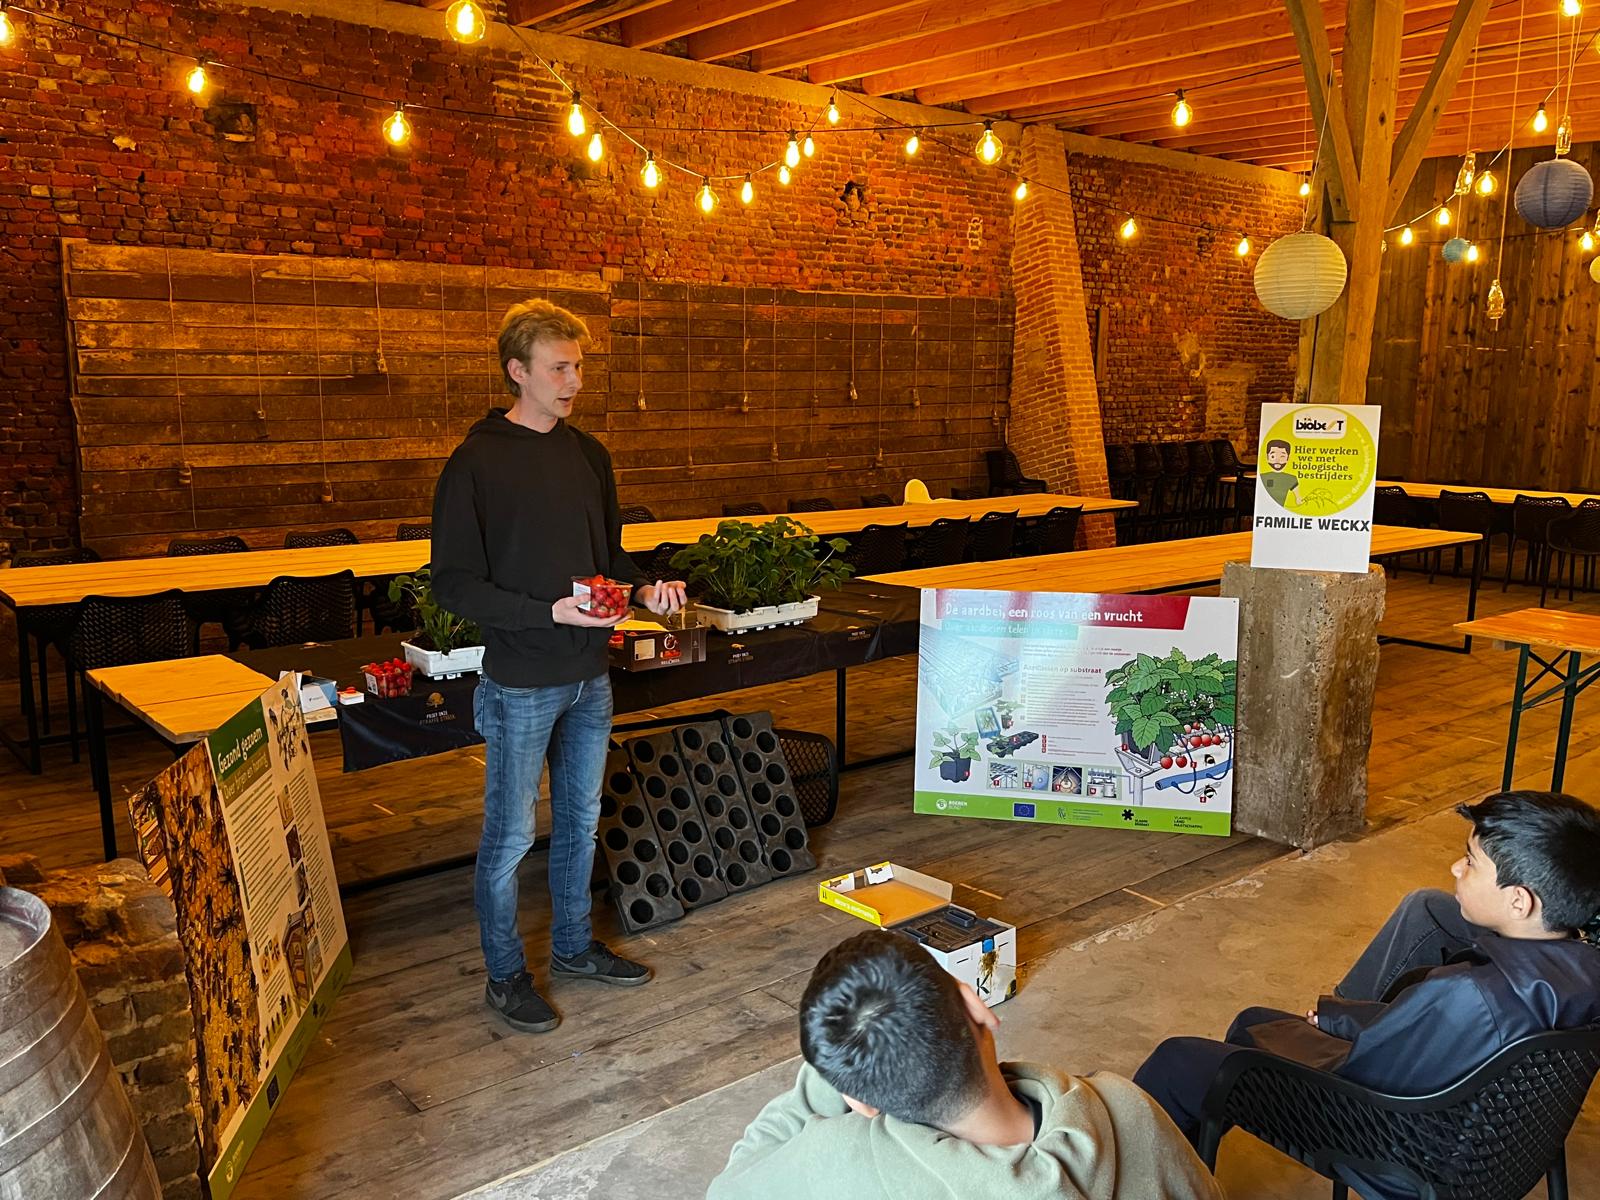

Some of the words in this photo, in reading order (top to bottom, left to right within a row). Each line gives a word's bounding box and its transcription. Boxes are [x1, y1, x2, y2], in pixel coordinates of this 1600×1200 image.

[1294, 445, 1317, 455] Hier
[1320, 446, 1359, 456] werken
[1292, 462, 1349, 473] biologische
[1297, 471, 1353, 482] bestrijders
[1255, 516, 1313, 530] FAMILIE
[1318, 518, 1370, 532] WECKX
[945, 603, 959, 616] De
[961, 604, 1006, 619] aardbei,
[1008, 608, 1029, 618] een
[1030, 608, 1056, 620] roos
[1058, 608, 1078, 620] van
[1081, 609, 1101, 621] een
[1103, 609, 1144, 623] vrucht
[1008, 623, 1029, 635] telen
[217, 738, 241, 774] Gezond
[241, 727, 262, 760] gezoem
